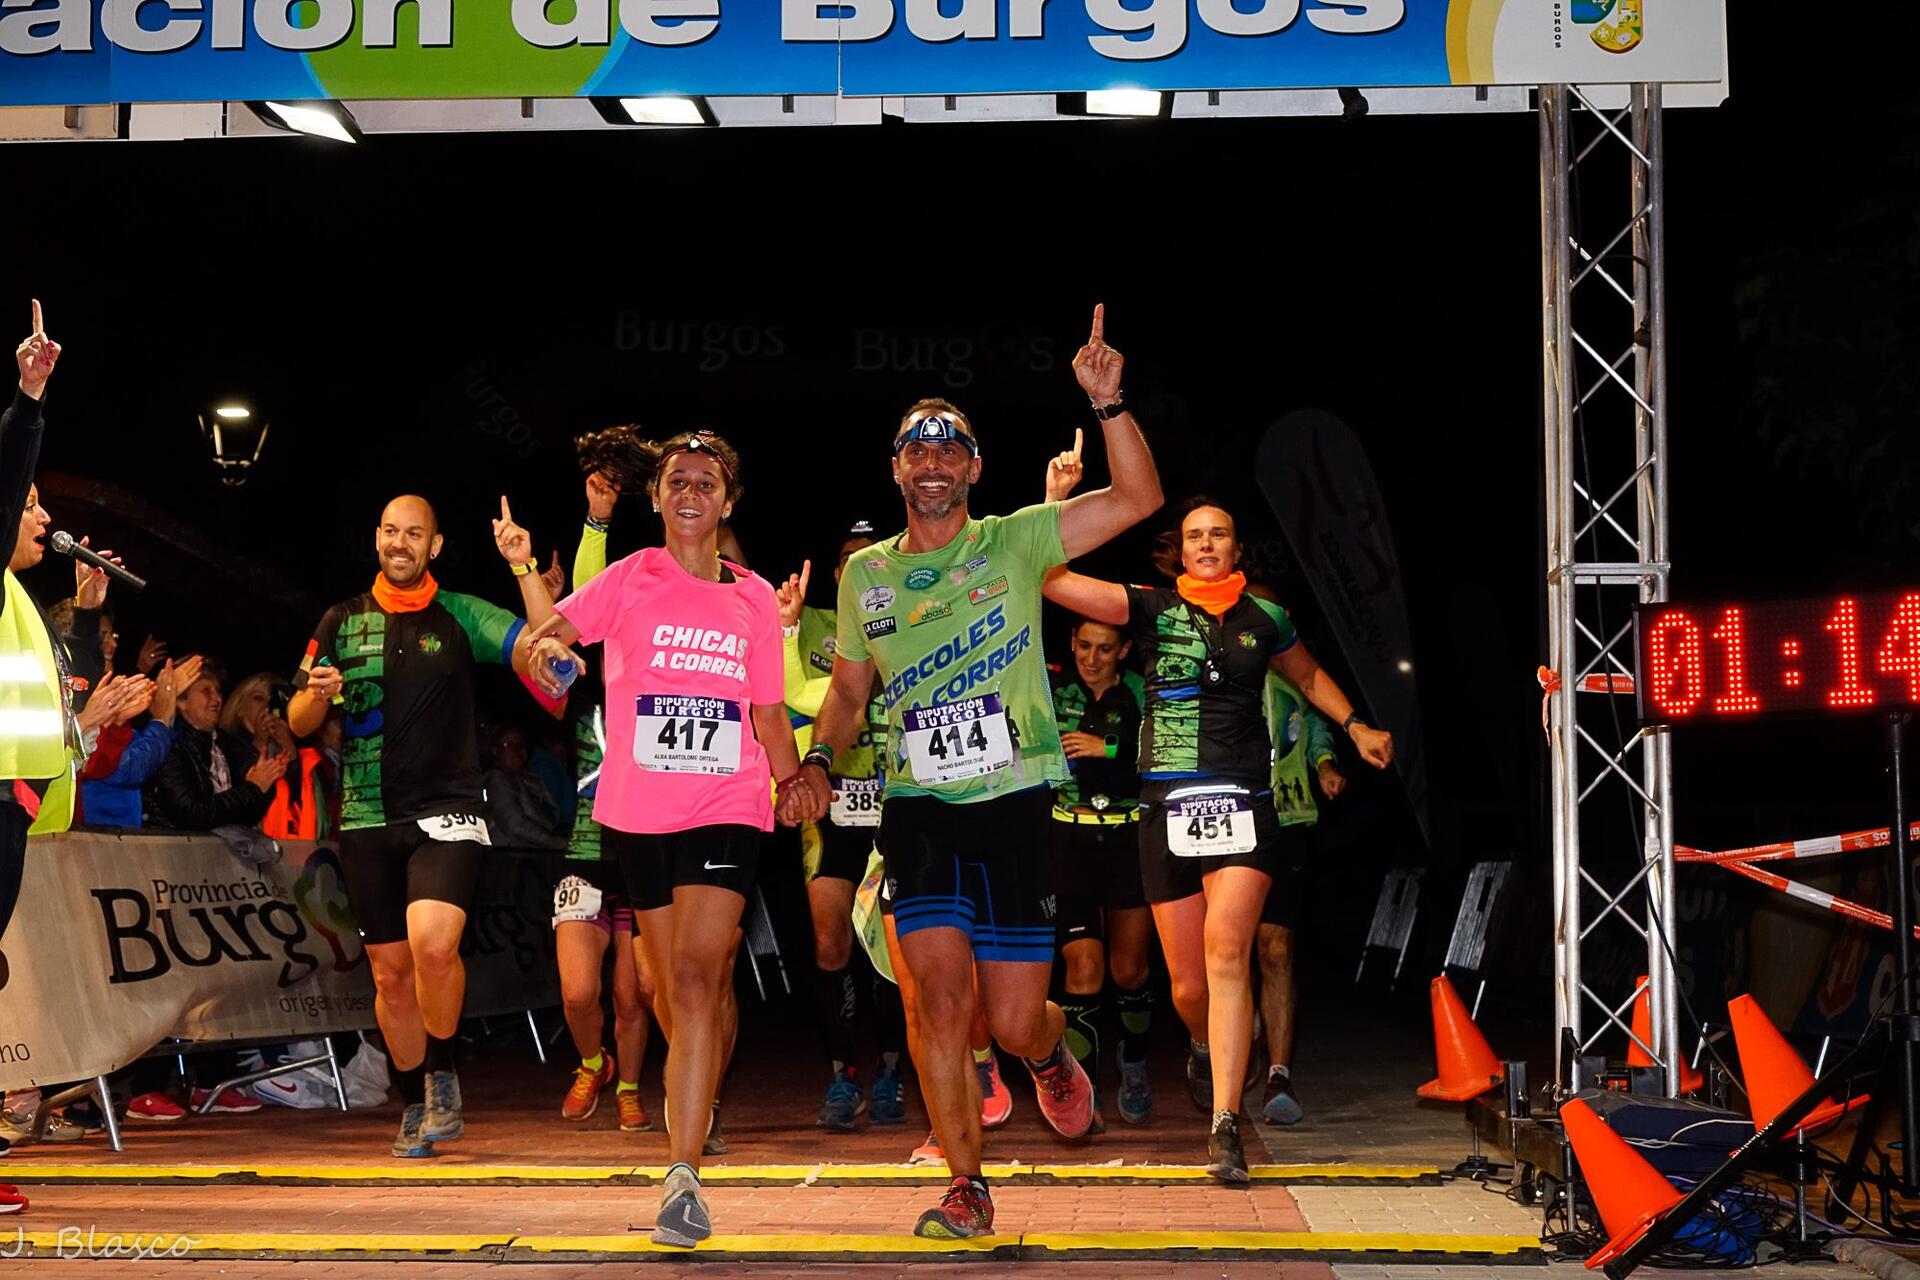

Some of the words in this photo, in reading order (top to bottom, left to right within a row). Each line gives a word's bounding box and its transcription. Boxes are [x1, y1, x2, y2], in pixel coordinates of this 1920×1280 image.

[511, 0, 721, 47] de
[652, 624, 748, 660] CHICAS
[650, 651, 666, 668] A
[653, 705, 725, 719] BURGOS
[654, 696, 725, 710] DIPUTACIÓN
[915, 697, 984, 720] DIPUTACIÓN
[918, 706, 987, 729] BURGOS
[657, 718, 720, 752] 417
[928, 720, 989, 760] 414
[1180, 797, 1237, 810] DIPUTACIÓN
[1187, 814, 1233, 840] 451
[151, 876, 272, 904] Provincia
